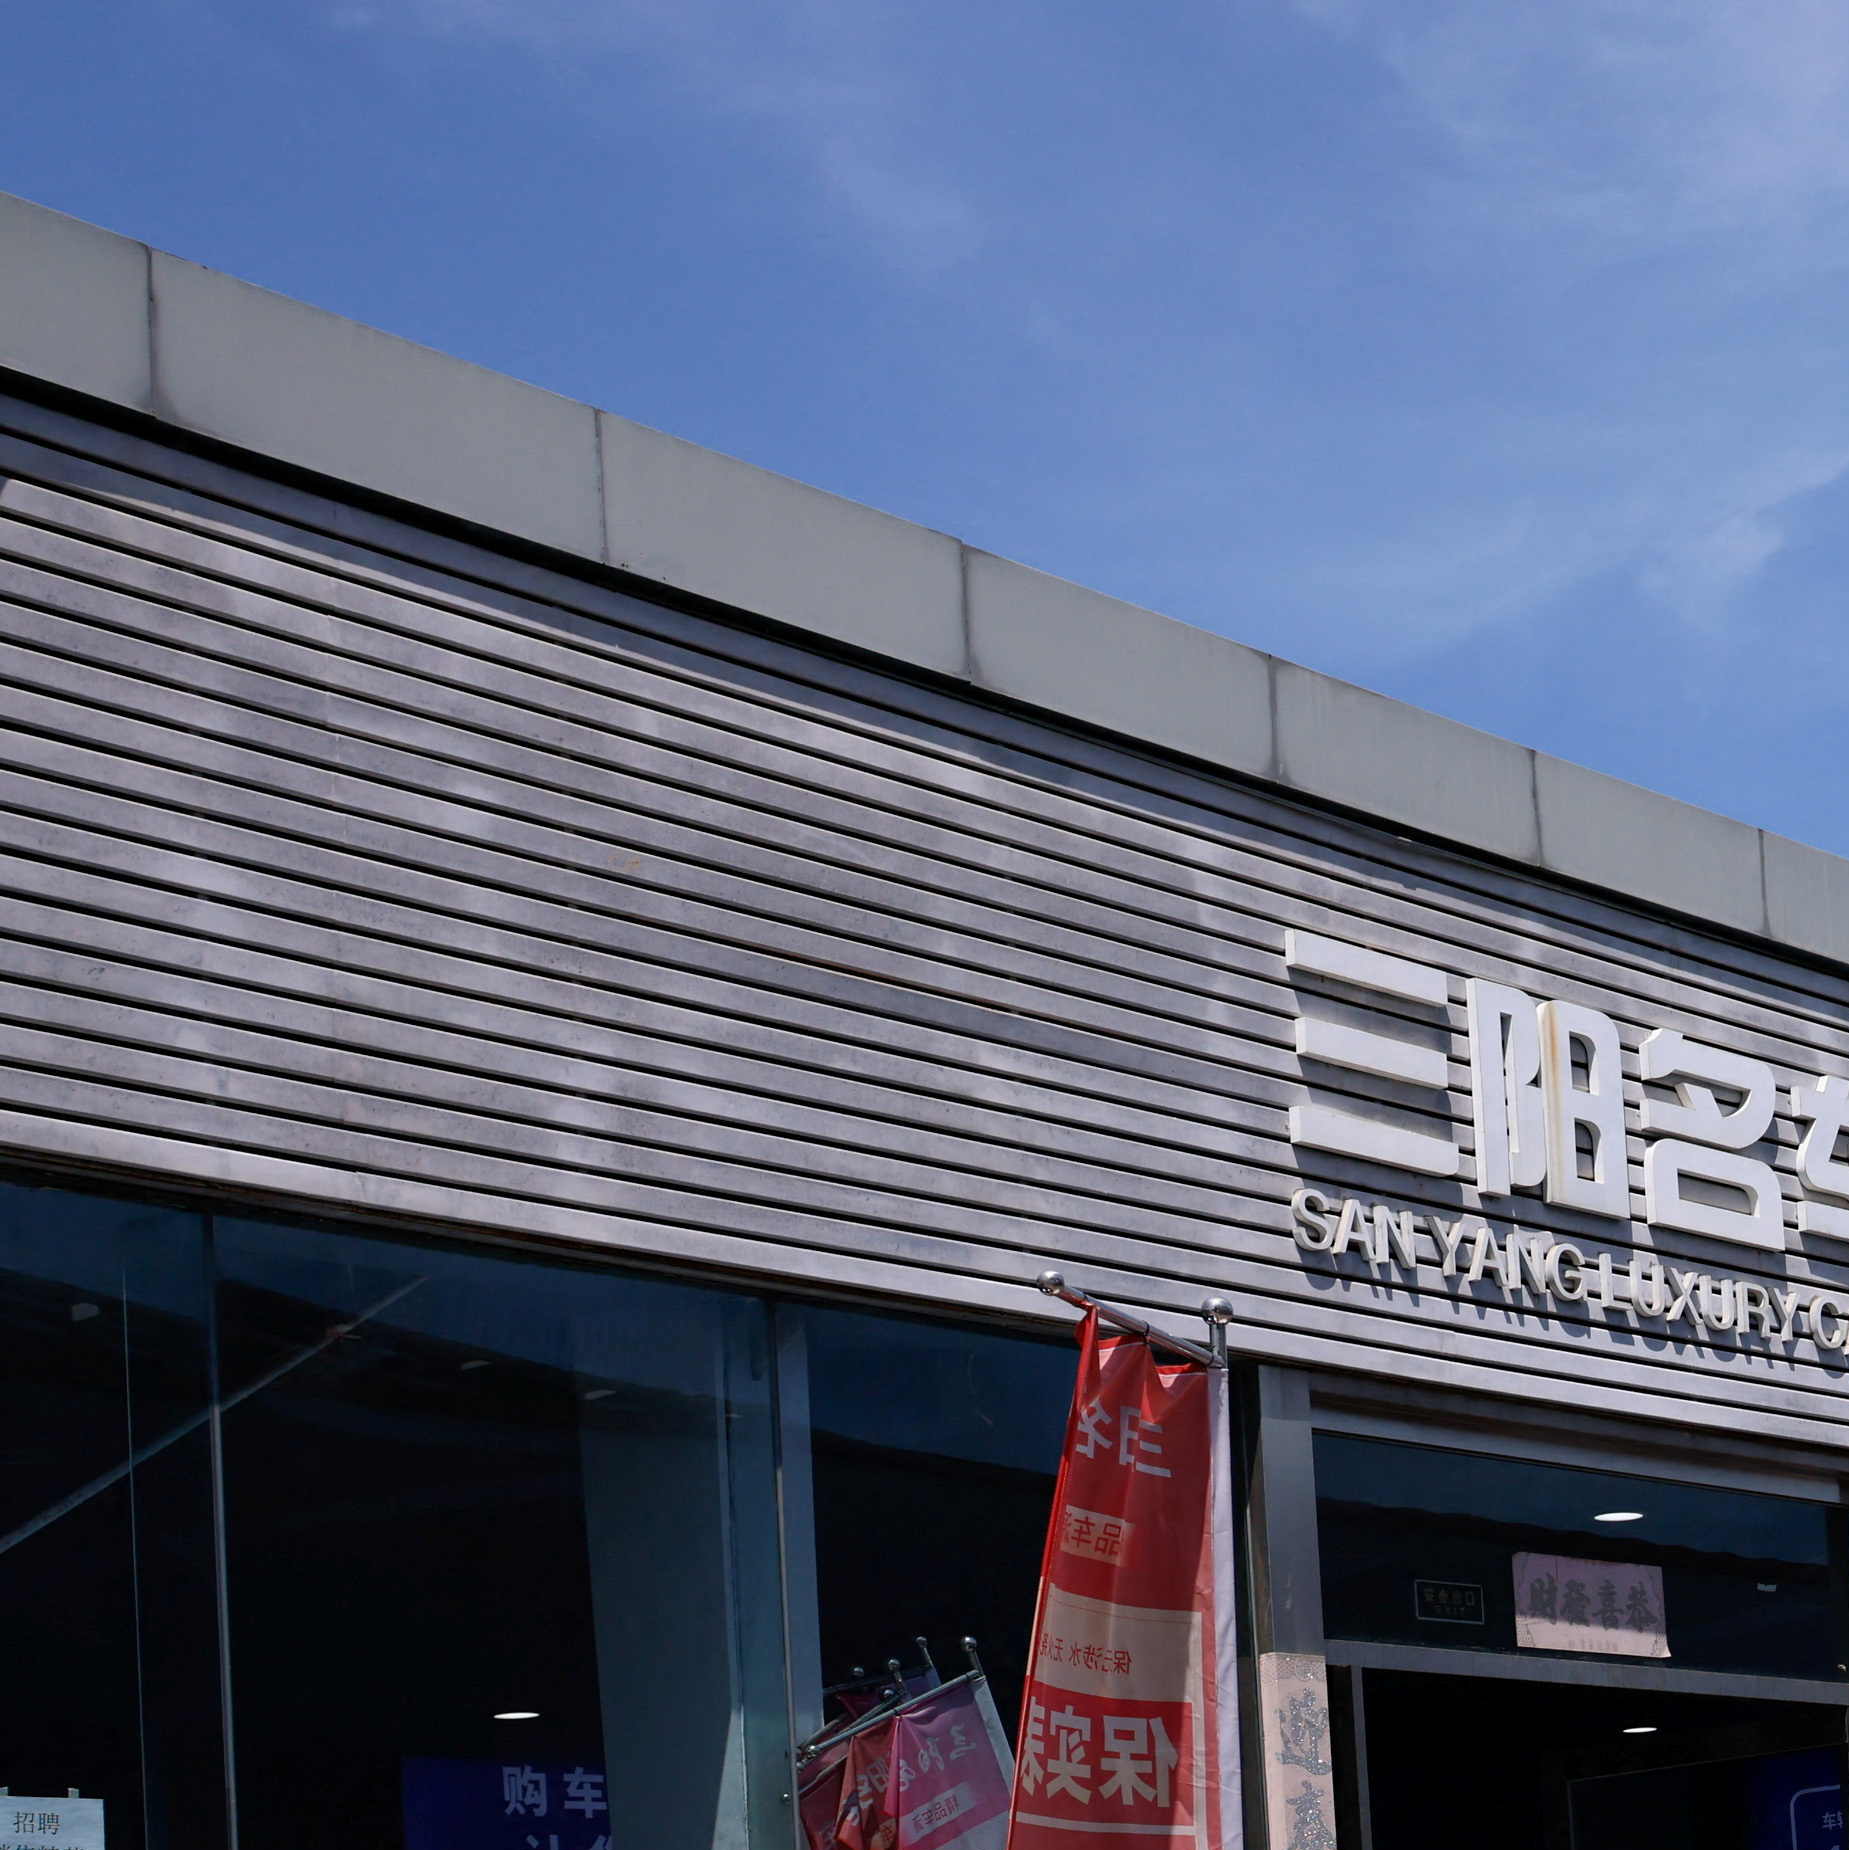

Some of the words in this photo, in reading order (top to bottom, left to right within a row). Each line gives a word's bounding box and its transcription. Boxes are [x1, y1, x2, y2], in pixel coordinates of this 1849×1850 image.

[1291, 1188, 1417, 1270] SAN
[1426, 1214, 1588, 1302] YANG
[1600, 1252, 1797, 1343] LUXURY
[1434, 1604, 1466, 1616] EXIT
[13, 1811, 60, 1835] 招聘
